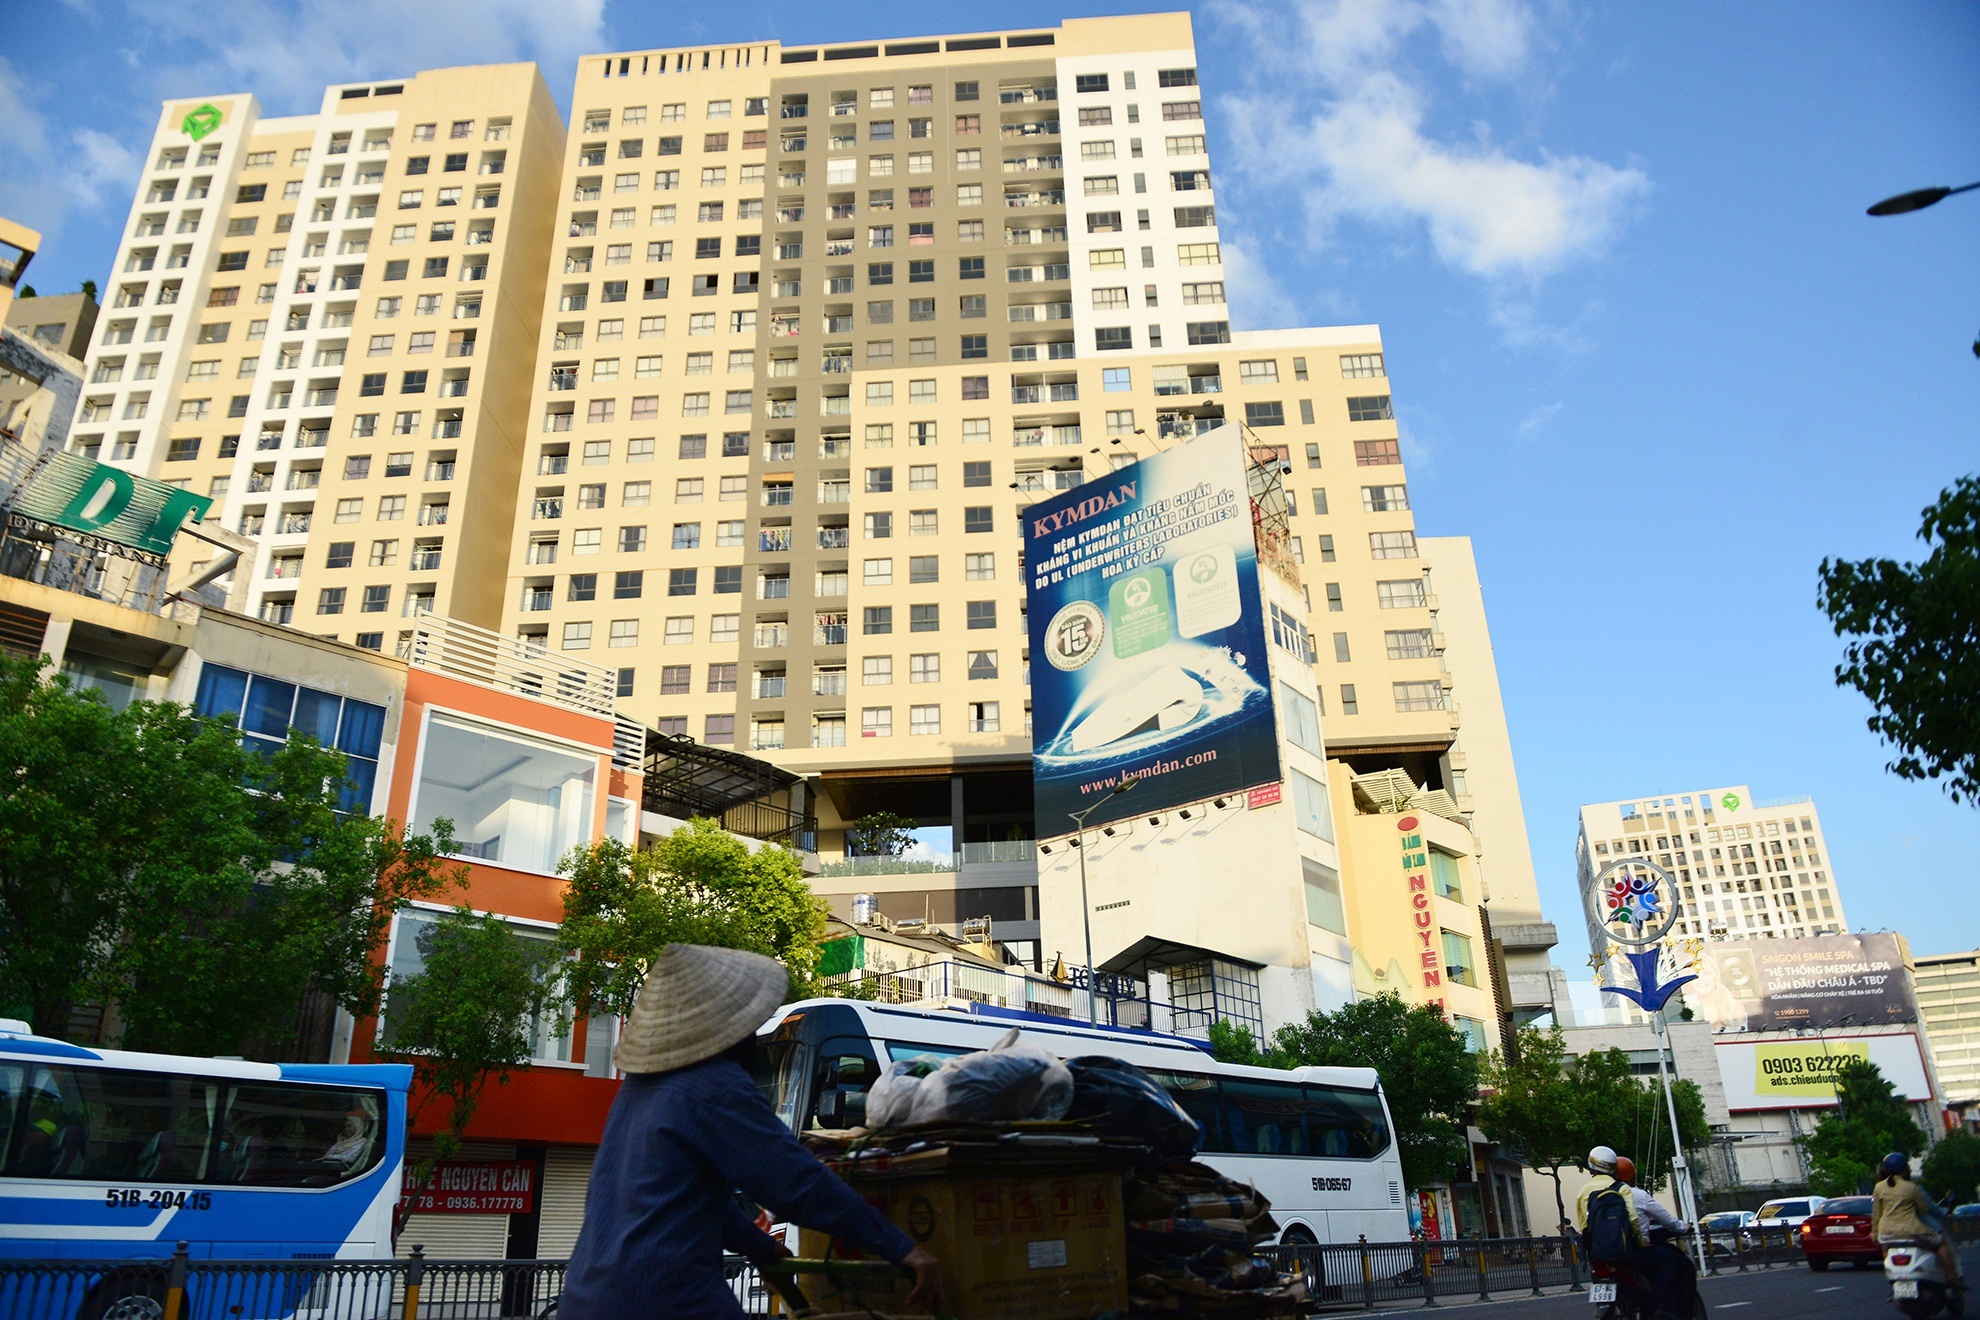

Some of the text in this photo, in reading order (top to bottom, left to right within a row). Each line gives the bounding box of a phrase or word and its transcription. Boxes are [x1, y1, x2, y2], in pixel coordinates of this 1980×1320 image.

[1033, 481, 1137, 539] KYMDAN
[1036, 554, 1070, 576] KHÁNG
[1072, 549, 1083, 562] VI
[1122, 525, 1137, 542] VÀ
[1138, 511, 1177, 536] KHÁNG
[1178, 500, 1206, 521] NẤM
[1208, 488, 1235, 510] MỐC
[1053, 536, 1076, 555] NỆM
[1078, 519, 1121, 545] KYMDAN
[1123, 510, 1144, 528] ĐẠT
[1146, 499, 1171, 518] TIÊU
[1035, 504, 1239, 591] DO UL (UNDERWRITERS LABORATORIES)
[1101, 545, 1166, 580] HOA KỲ CẤP
[1186, 581, 1227, 599] VALIDATED
[1120, 604, 1159, 623] VALIDATED
[1060, 623, 1087, 656] 15
[1803, 951, 1834, 962] SMILE
[1834, 950, 1855, 961] SPA
[1784, 964, 1823, 976] THỐNG
[1824, 962, 1871, 975] MEDICAL
[1871, 961, 1891, 972] SPA
[1817, 976, 1847, 988] CHÂU
[1848, 974, 1857, 987] Á
[1762, 1057, 1803, 1075] 0903
[441, 1164, 499, 1192] NGUYÊN
[501, 1164, 531, 1192] CĂN
[105, 1188, 212, 1211] 51B-204.15
[446, 1196, 524, 1210] 0936.177778
